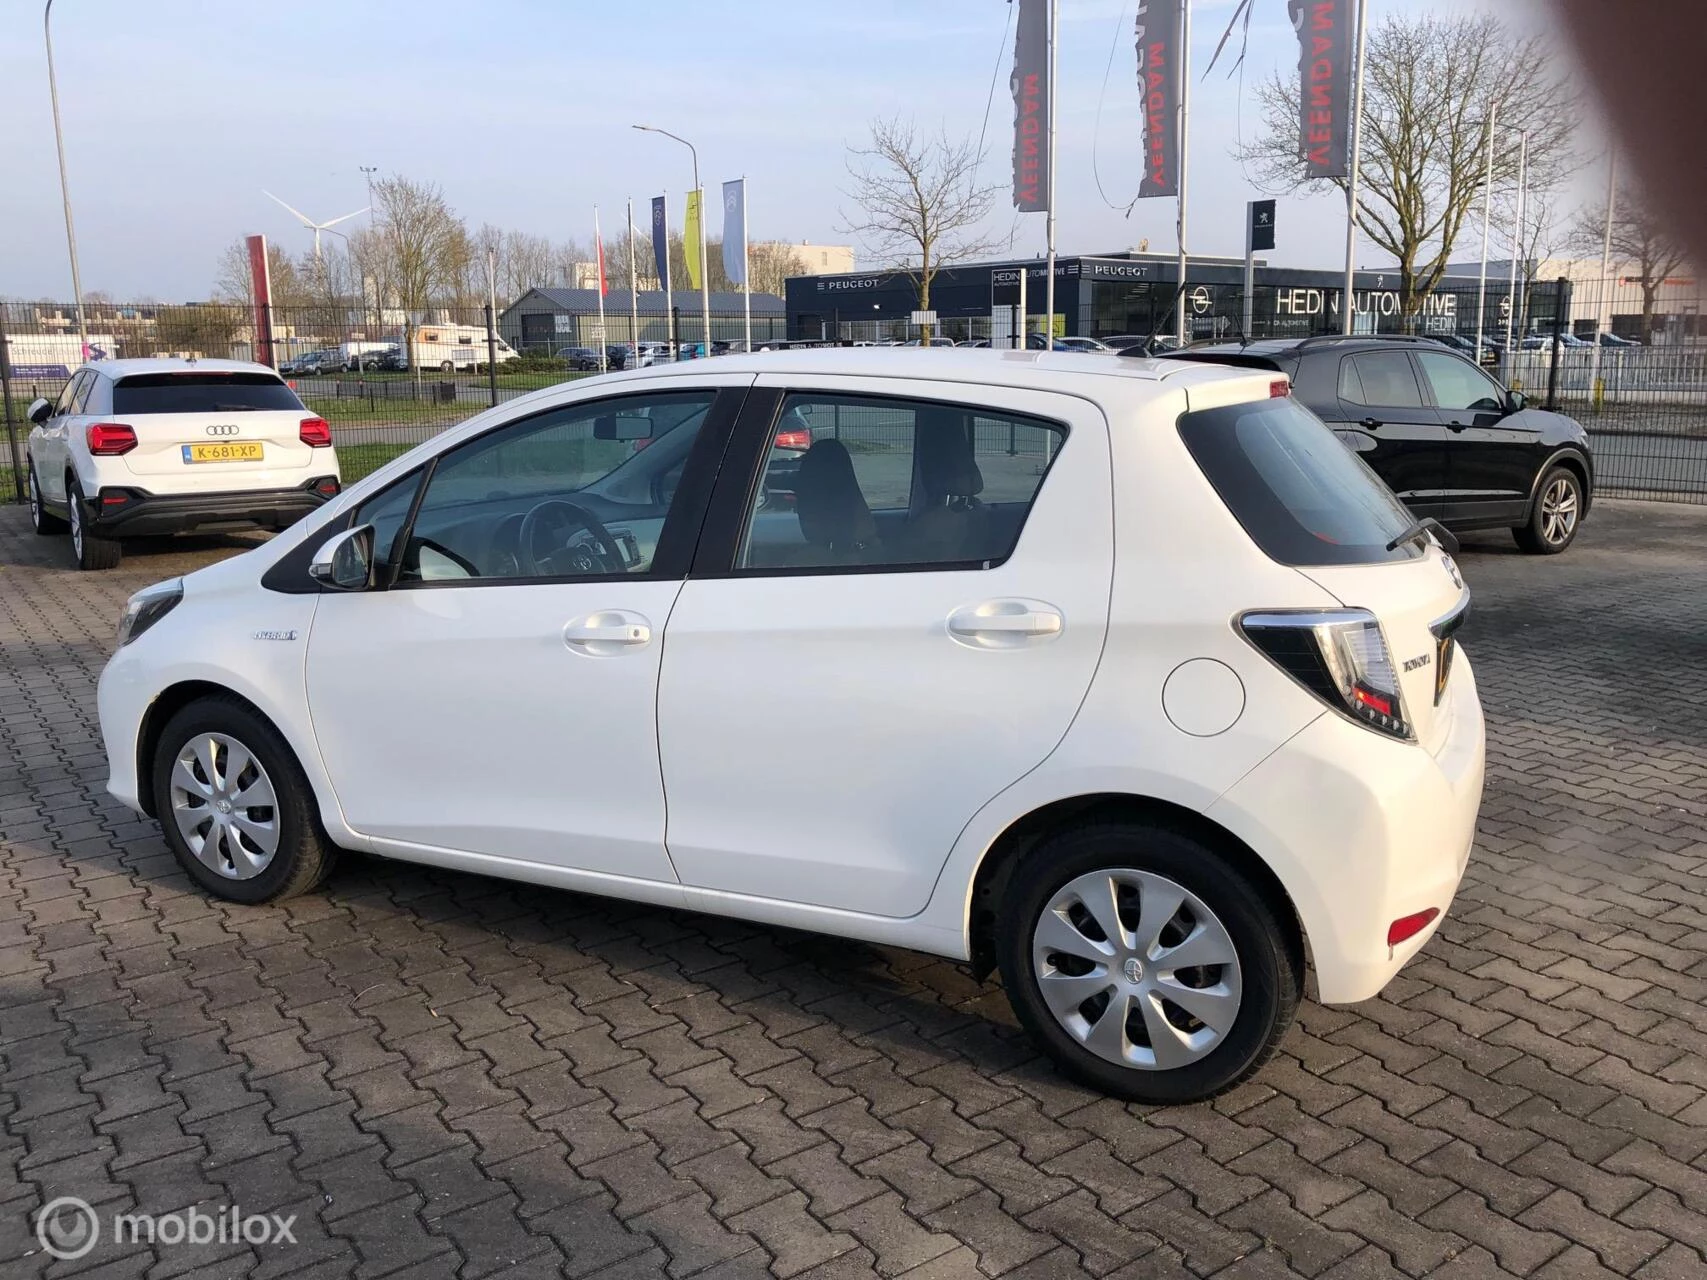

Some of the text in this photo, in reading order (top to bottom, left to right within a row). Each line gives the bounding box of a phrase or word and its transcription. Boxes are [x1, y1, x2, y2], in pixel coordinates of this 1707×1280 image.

[1095, 265, 1148, 276] PEUGEOT
[993, 272, 1020, 281] HEDIN
[828, 279, 879, 290] PEUGEOT
[1276, 288, 1340, 315] HEDIN
[1425, 317, 1457, 331] HEDIN
[198, 446, 256, 458] K-681-XP
